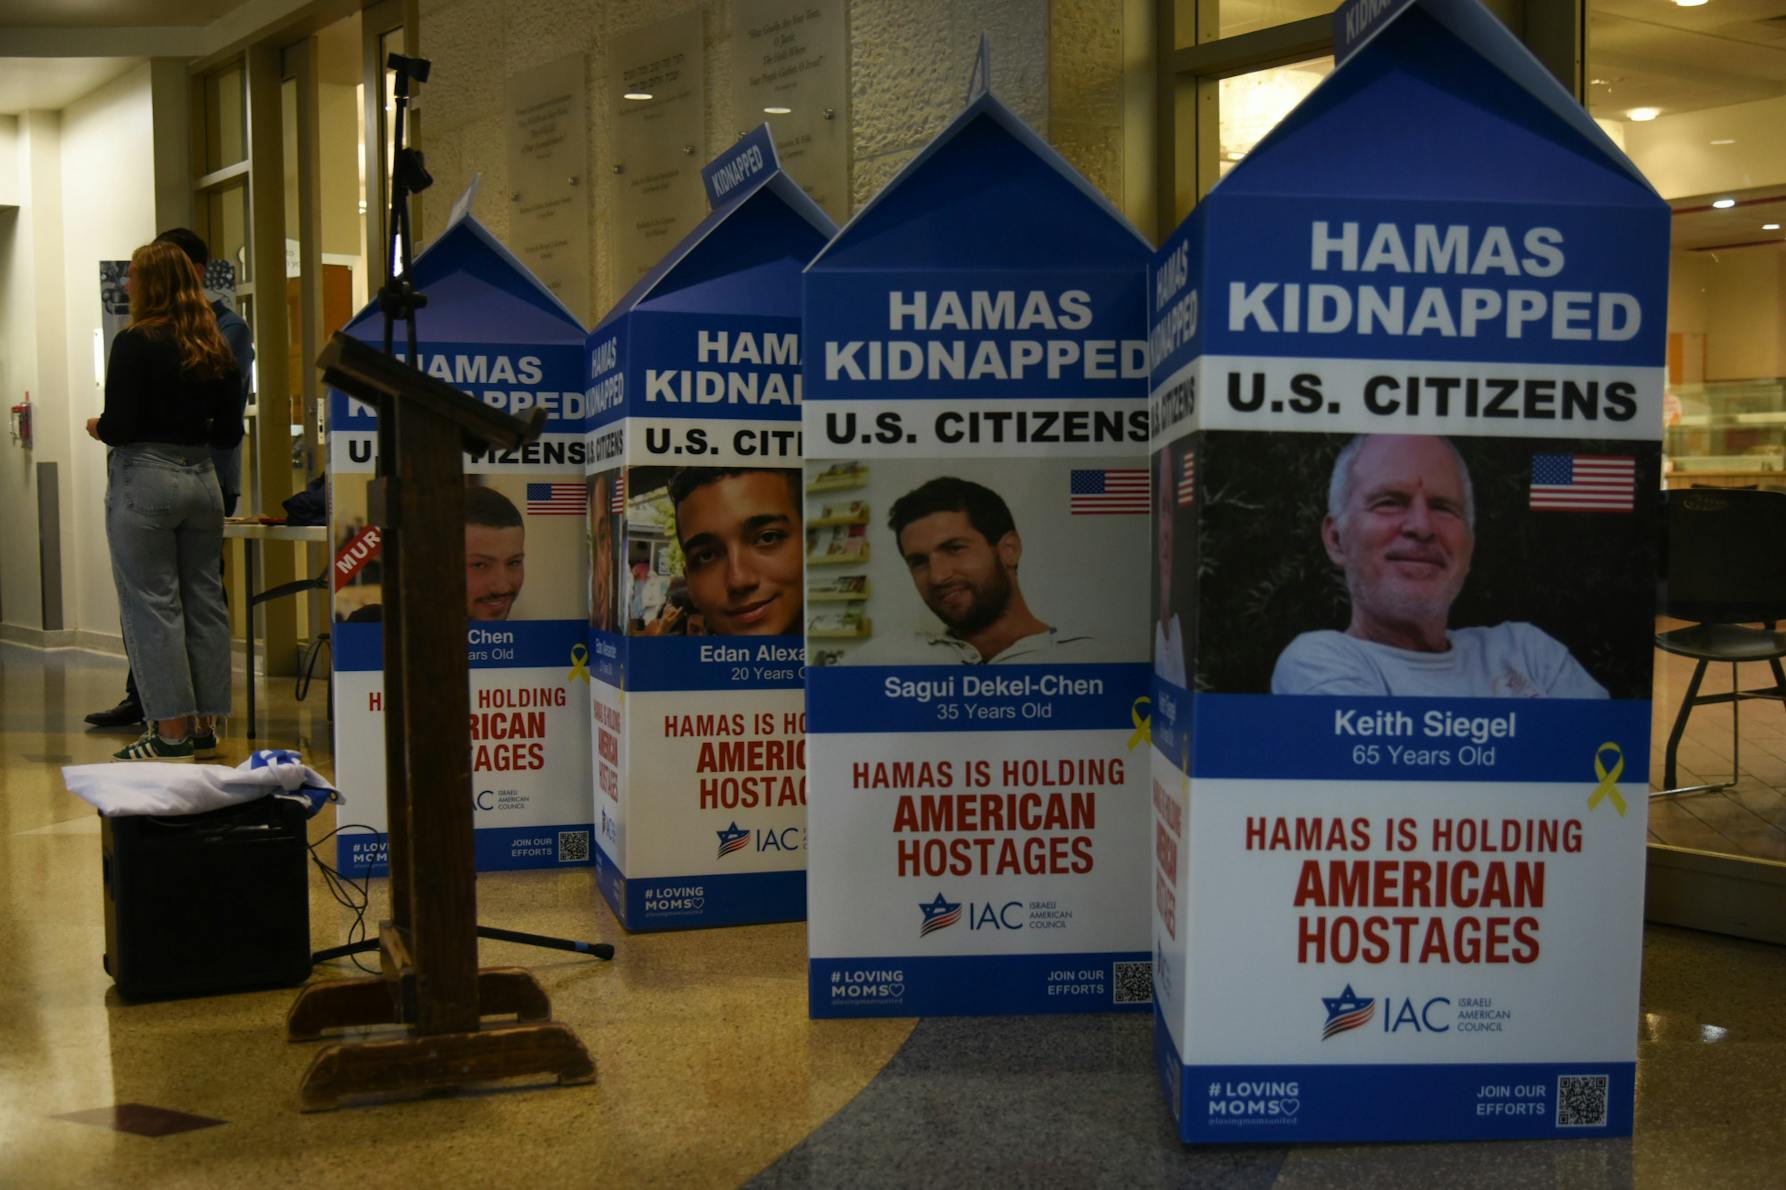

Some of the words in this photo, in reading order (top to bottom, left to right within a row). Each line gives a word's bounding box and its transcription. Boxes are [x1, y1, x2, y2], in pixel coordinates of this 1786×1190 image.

[711, 144, 764, 198] KIDNAPPED
[1310, 220, 1566, 277] HAMAS
[889, 289, 1094, 331] HAMAS
[1228, 281, 1643, 342] KIDNAPPED
[697, 330, 802, 366] HAM
[824, 339, 1149, 381] KIDNAPPED
[645, 369, 803, 406] KIDNA
[1227, 372, 1341, 413] U.S.
[1363, 375, 1637, 422] CITIZENS
[826, 412, 917, 444] U.S.
[935, 410, 1149, 444] CITIZENS
[646, 428, 719, 455] U.S.
[336, 526, 382, 574] MUR
[468, 629, 514, 644] Chen
[467, 650, 488, 661] ars
[491, 647, 514, 660] Old
[700, 645, 750, 662] Edan
[756, 645, 806, 662] Alexa
[731, 668, 749, 681] 20
[753, 667, 794, 680] Years
[479, 687, 567, 709] HOLDING
[884, 675, 955, 702] Sagui
[962, 674, 1104, 697] Dekel-Chen
[936, 703, 959, 720] 35
[964, 703, 1017, 720] Years
[1021, 702, 1052, 719] Old
[469, 711, 546, 740] RICAN
[664, 714, 745, 738] HAMAS
[754, 713, 774, 735] IS
[1334, 709, 1414, 738] Keith
[1422, 711, 1517, 745] Siegel
[470, 743, 545, 772] AGES
[1352, 745, 1381, 765] 65
[1387, 745, 1451, 767] Years
[1457, 745, 1496, 767] Old
[853, 761, 954, 789] HAMAS
[965, 760, 991, 787] IS
[1002, 758, 1125, 787] HOLDING
[700, 776, 807, 809] HOSTA
[893, 792, 1096, 833] AMERICAN
[512, 838, 533, 847] JOIN
[533, 837, 553, 847] OUR
[757, 827, 799, 852] IAC
[1245, 816, 1371, 852] HAMAS
[1386, 818, 1418, 853] IS
[1432, 818, 1583, 853] HOLDING
[353, 853, 388, 863] MOM
[511, 847, 553, 857] EFFORTS
[898, 836, 1094, 877] HOSTAGES
[1293, 859, 1545, 908] AMERICAN
[645, 899, 693, 911] MOMS
[970, 901, 1024, 930] IAC
[1029, 901, 1056, 909] ISRAELI
[1029, 911, 1073, 919] AMERICAN
[1029, 920, 1067, 929] COUNCIL
[1297, 915, 1541, 964] HOSTAGES
[1048, 970, 1075, 982] JOIN
[1078, 969, 1104, 981] OUR
[831, 985, 890, 998] MOMS
[1047, 984, 1104, 995] EFFORTS
[1384, 996, 1450, 1033] IAC
[1457, 998, 1492, 1008] ISRAELI
[1457, 1009, 1511, 1019] AMERICAN
[1457, 1021, 1503, 1032] COUNCIL
[1476, 1085, 1510, 1099] JOIN
[1513, 1084, 1546, 1098] OUR
[1208, 1099, 1281, 1115] MOMS
[1476, 1102, 1546, 1116] EFFORTS
